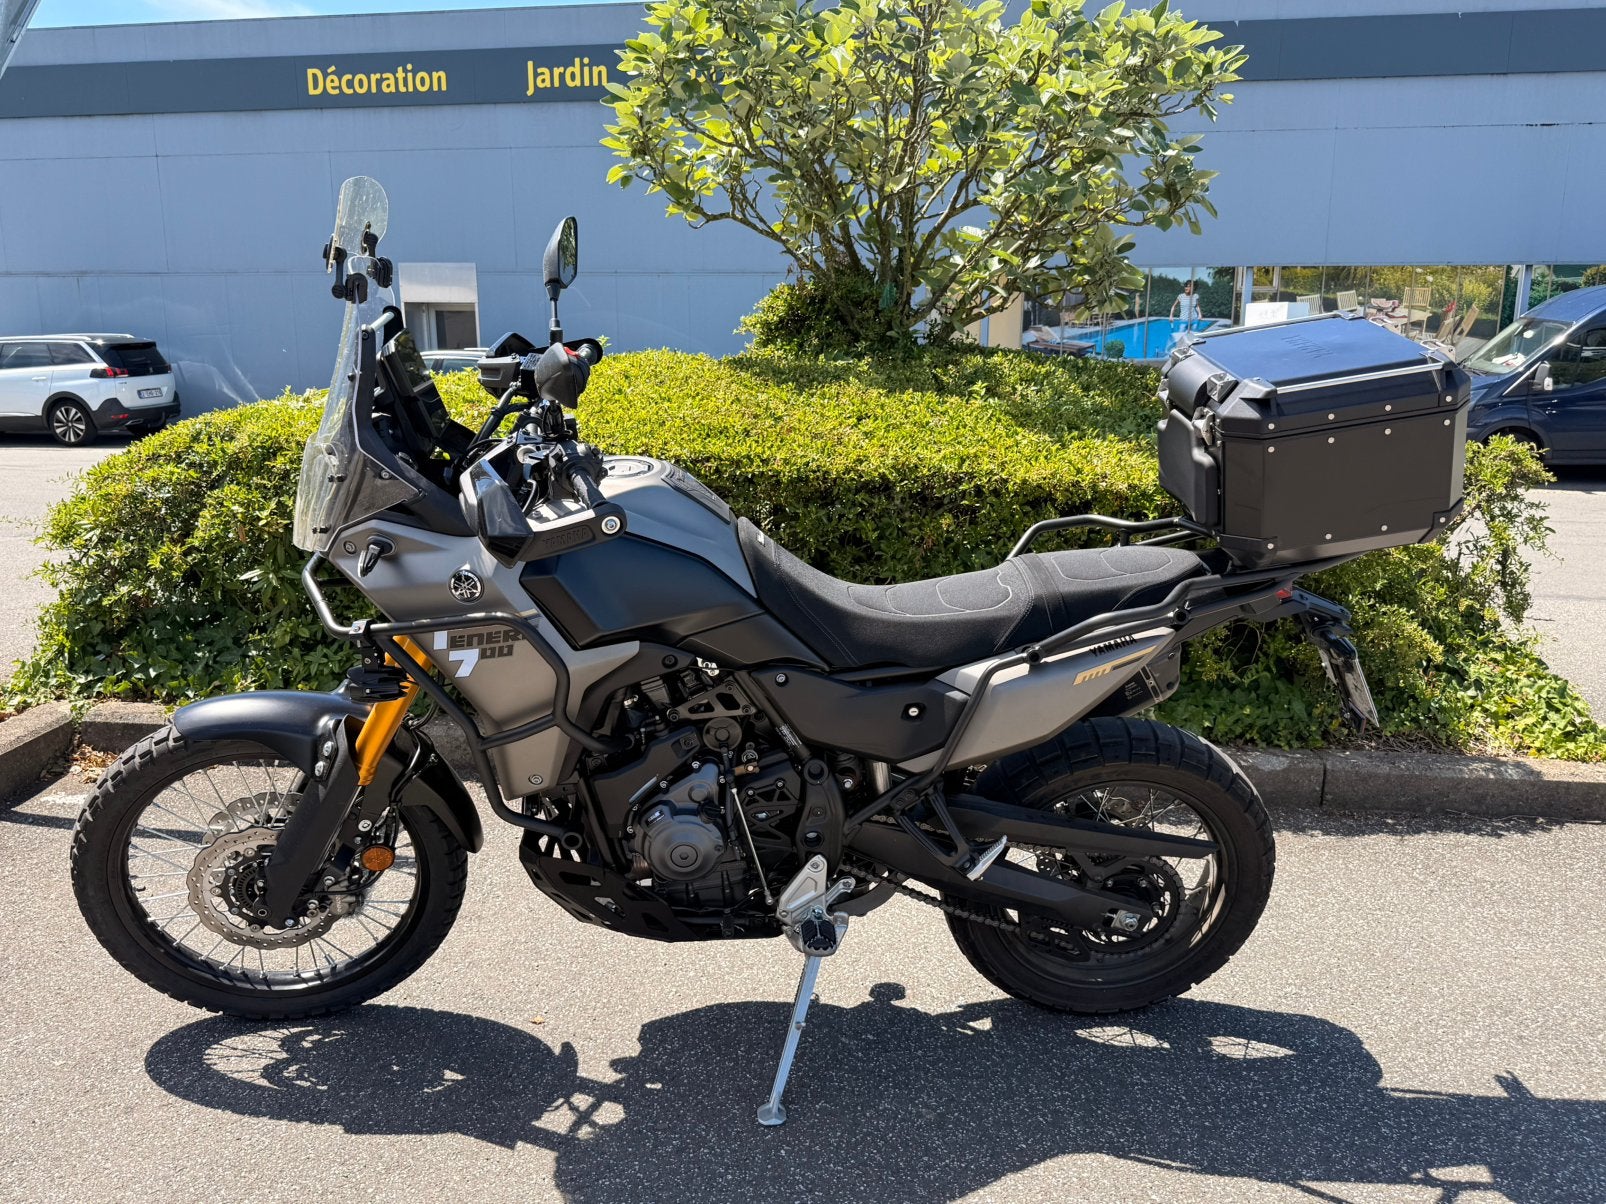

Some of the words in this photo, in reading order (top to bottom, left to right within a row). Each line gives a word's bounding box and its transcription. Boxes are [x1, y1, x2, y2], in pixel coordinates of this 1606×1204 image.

[306, 63, 447, 95] Décoration
[526, 57, 608, 96] Jardin
[448, 644, 515, 678] 700
[1089, 633, 1138, 657] YAMAHA
